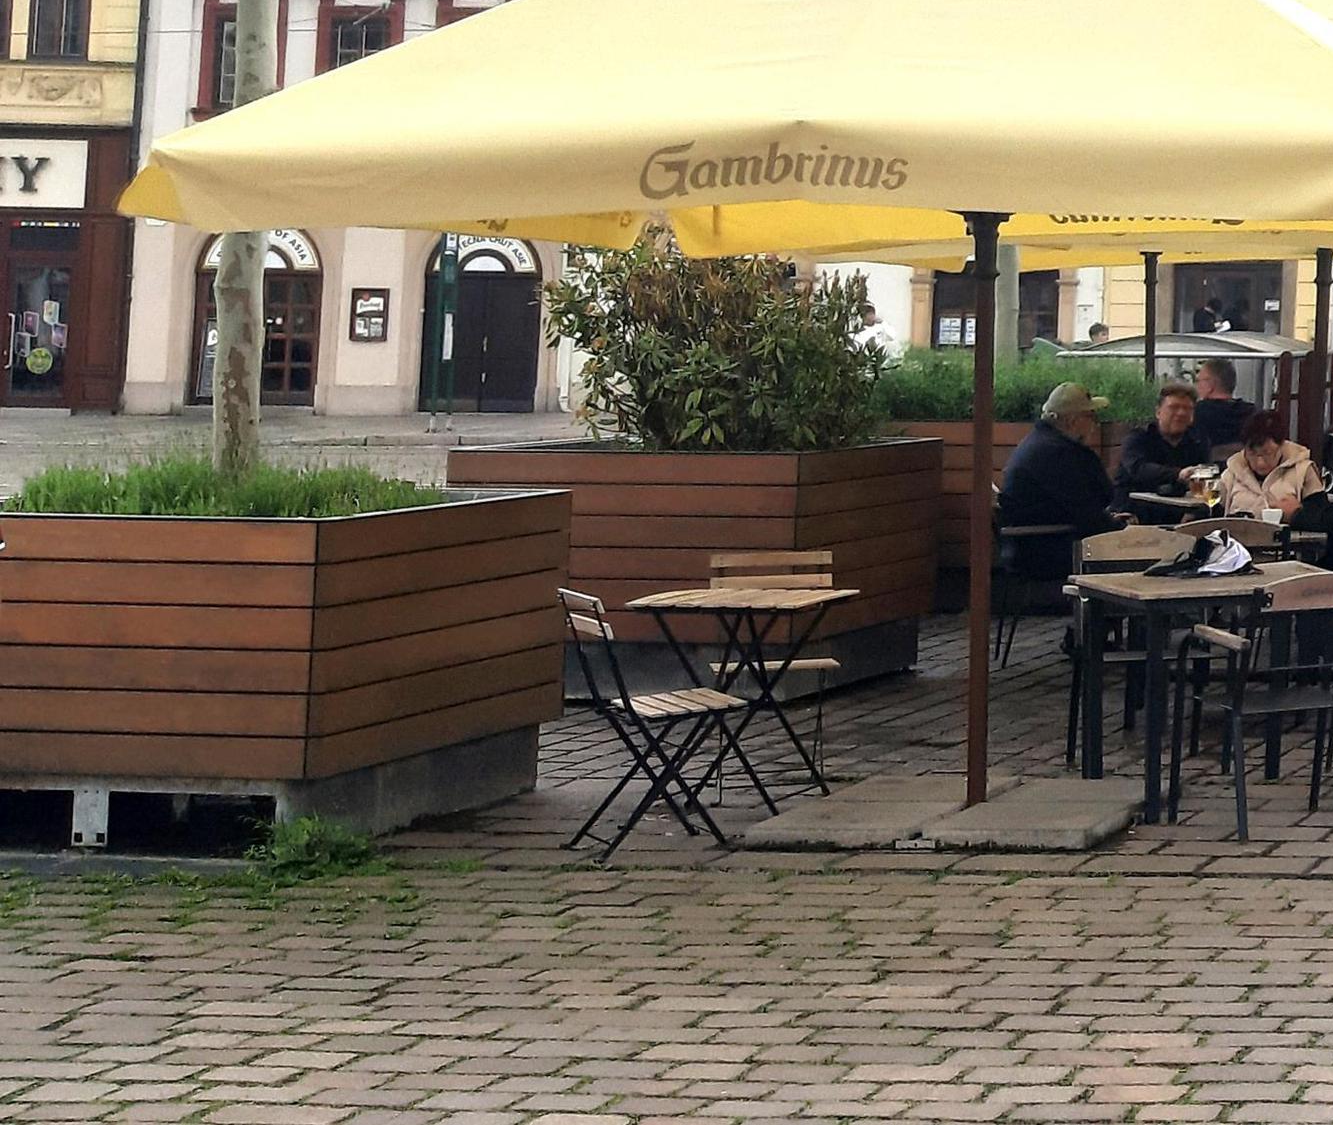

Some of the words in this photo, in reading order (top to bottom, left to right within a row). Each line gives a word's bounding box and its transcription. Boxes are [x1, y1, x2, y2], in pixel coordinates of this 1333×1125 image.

[0, 155, 51, 192] Y
[639, 140, 909, 200] Gambrinus
[288, 239, 308, 260] ASIA
